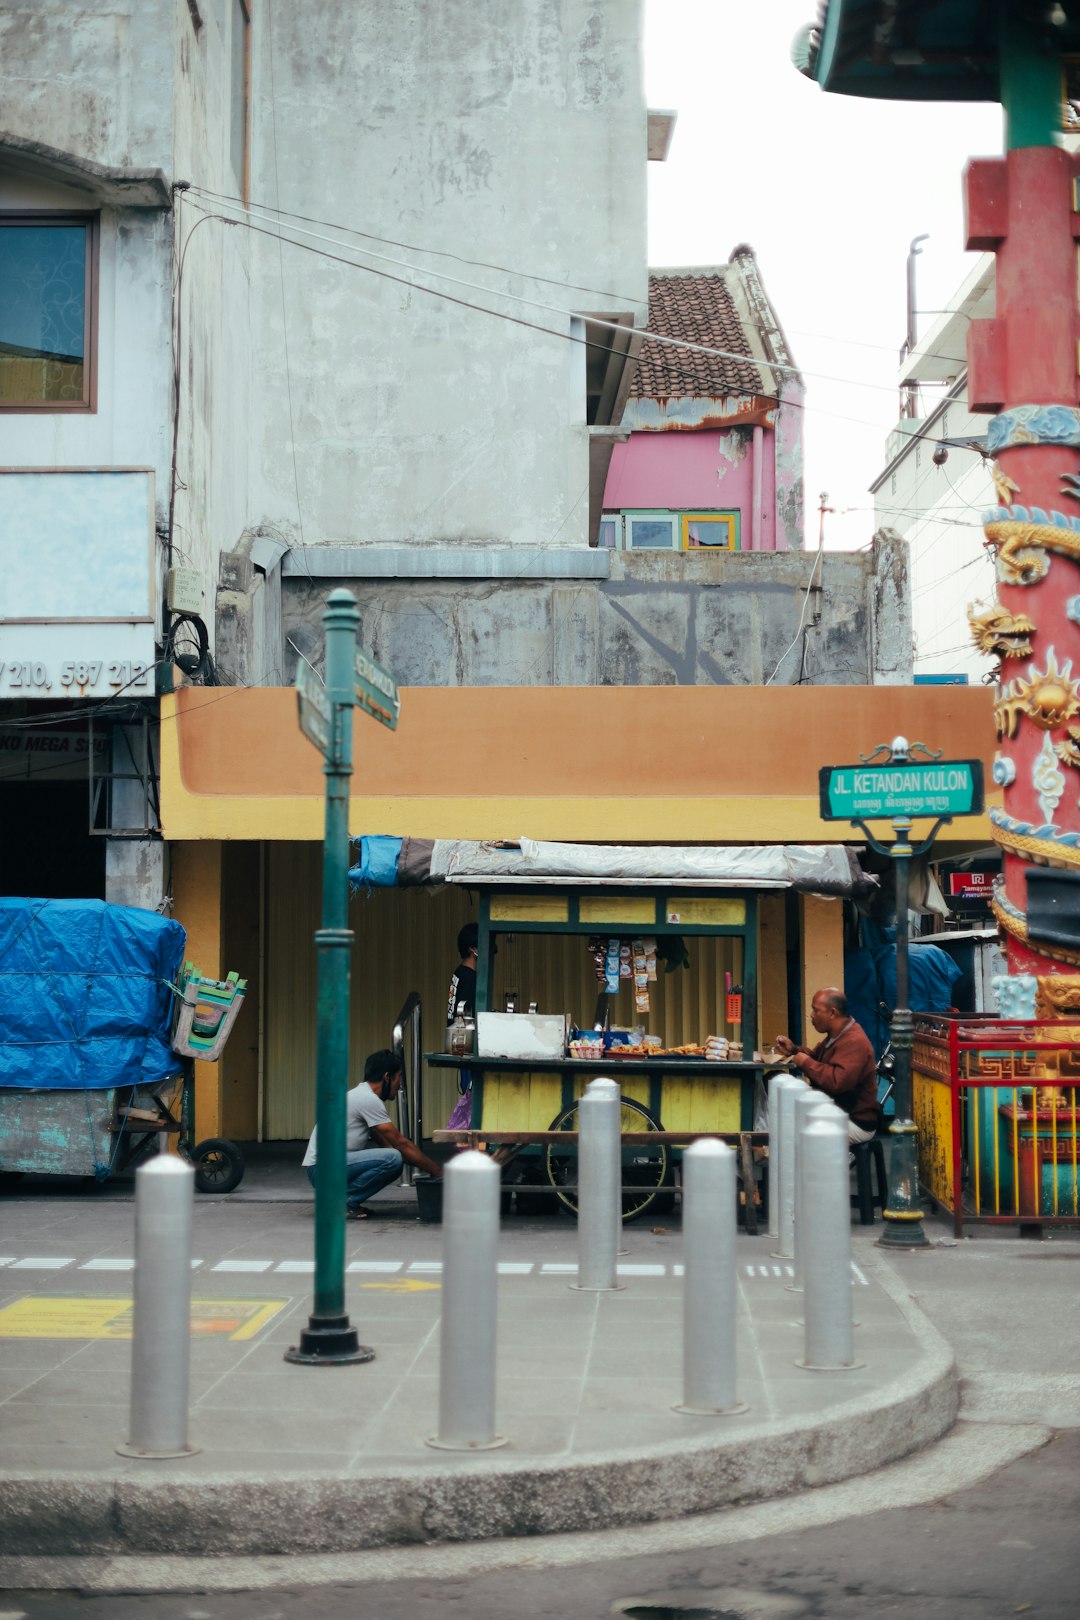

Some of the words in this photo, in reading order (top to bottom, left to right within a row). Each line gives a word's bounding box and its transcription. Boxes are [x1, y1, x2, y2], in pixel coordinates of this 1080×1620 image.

[9, 660, 52, 690] 210,
[61, 660, 103, 686] 587
[109, 660, 148, 686] 212
[25, 737, 70, 752] MEGA
[834, 775, 851, 795] JL.
[854, 772, 921, 794] KETANDAN
[923, 770, 967, 792] KULON
